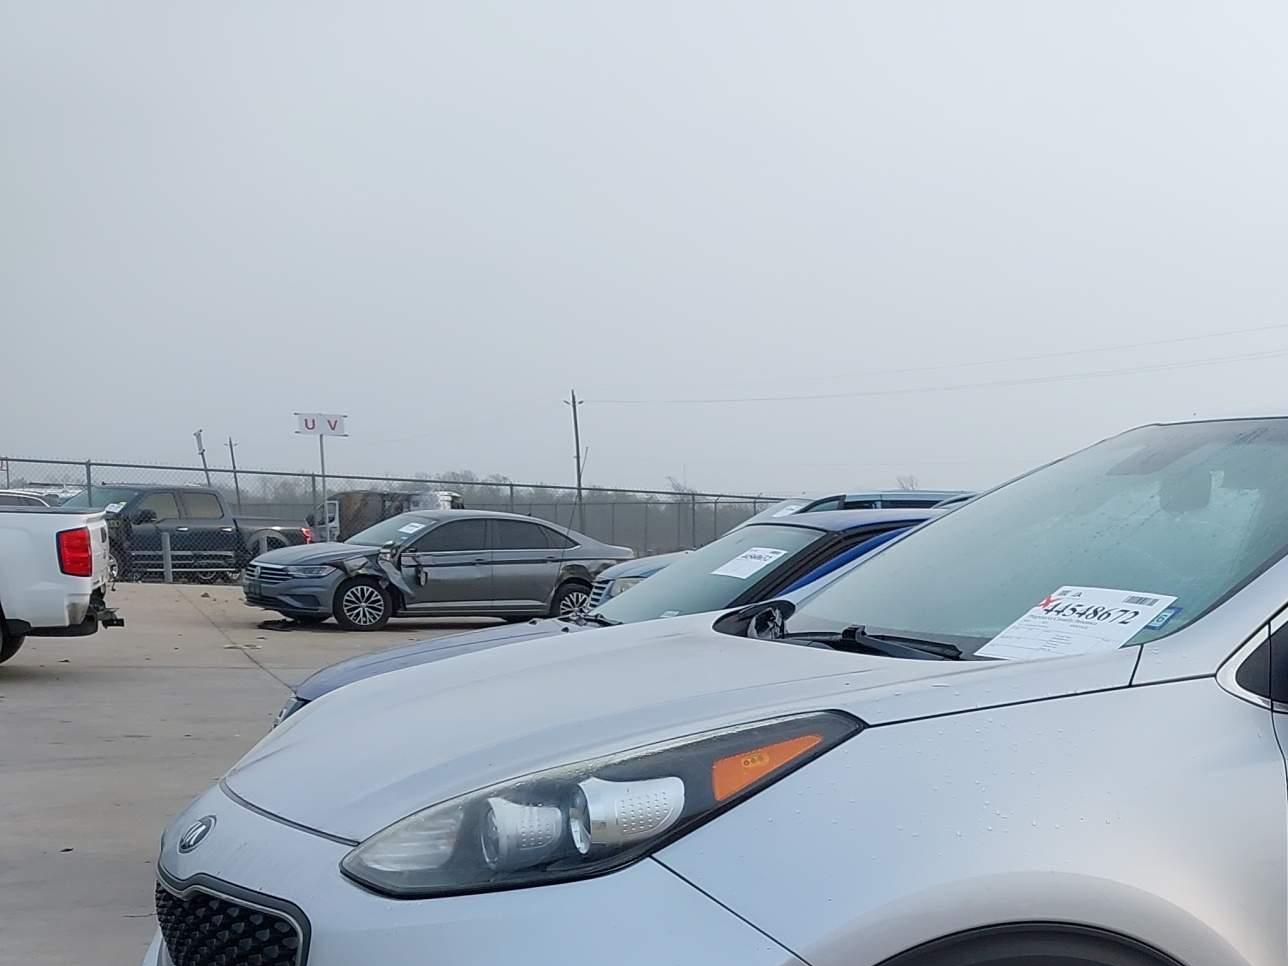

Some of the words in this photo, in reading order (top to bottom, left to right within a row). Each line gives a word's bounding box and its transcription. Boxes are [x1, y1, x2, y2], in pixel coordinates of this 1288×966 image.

[304, 418, 316, 431] U
[327, 419, 338, 431] V
[1043, 601, 1140, 625] 44548672
